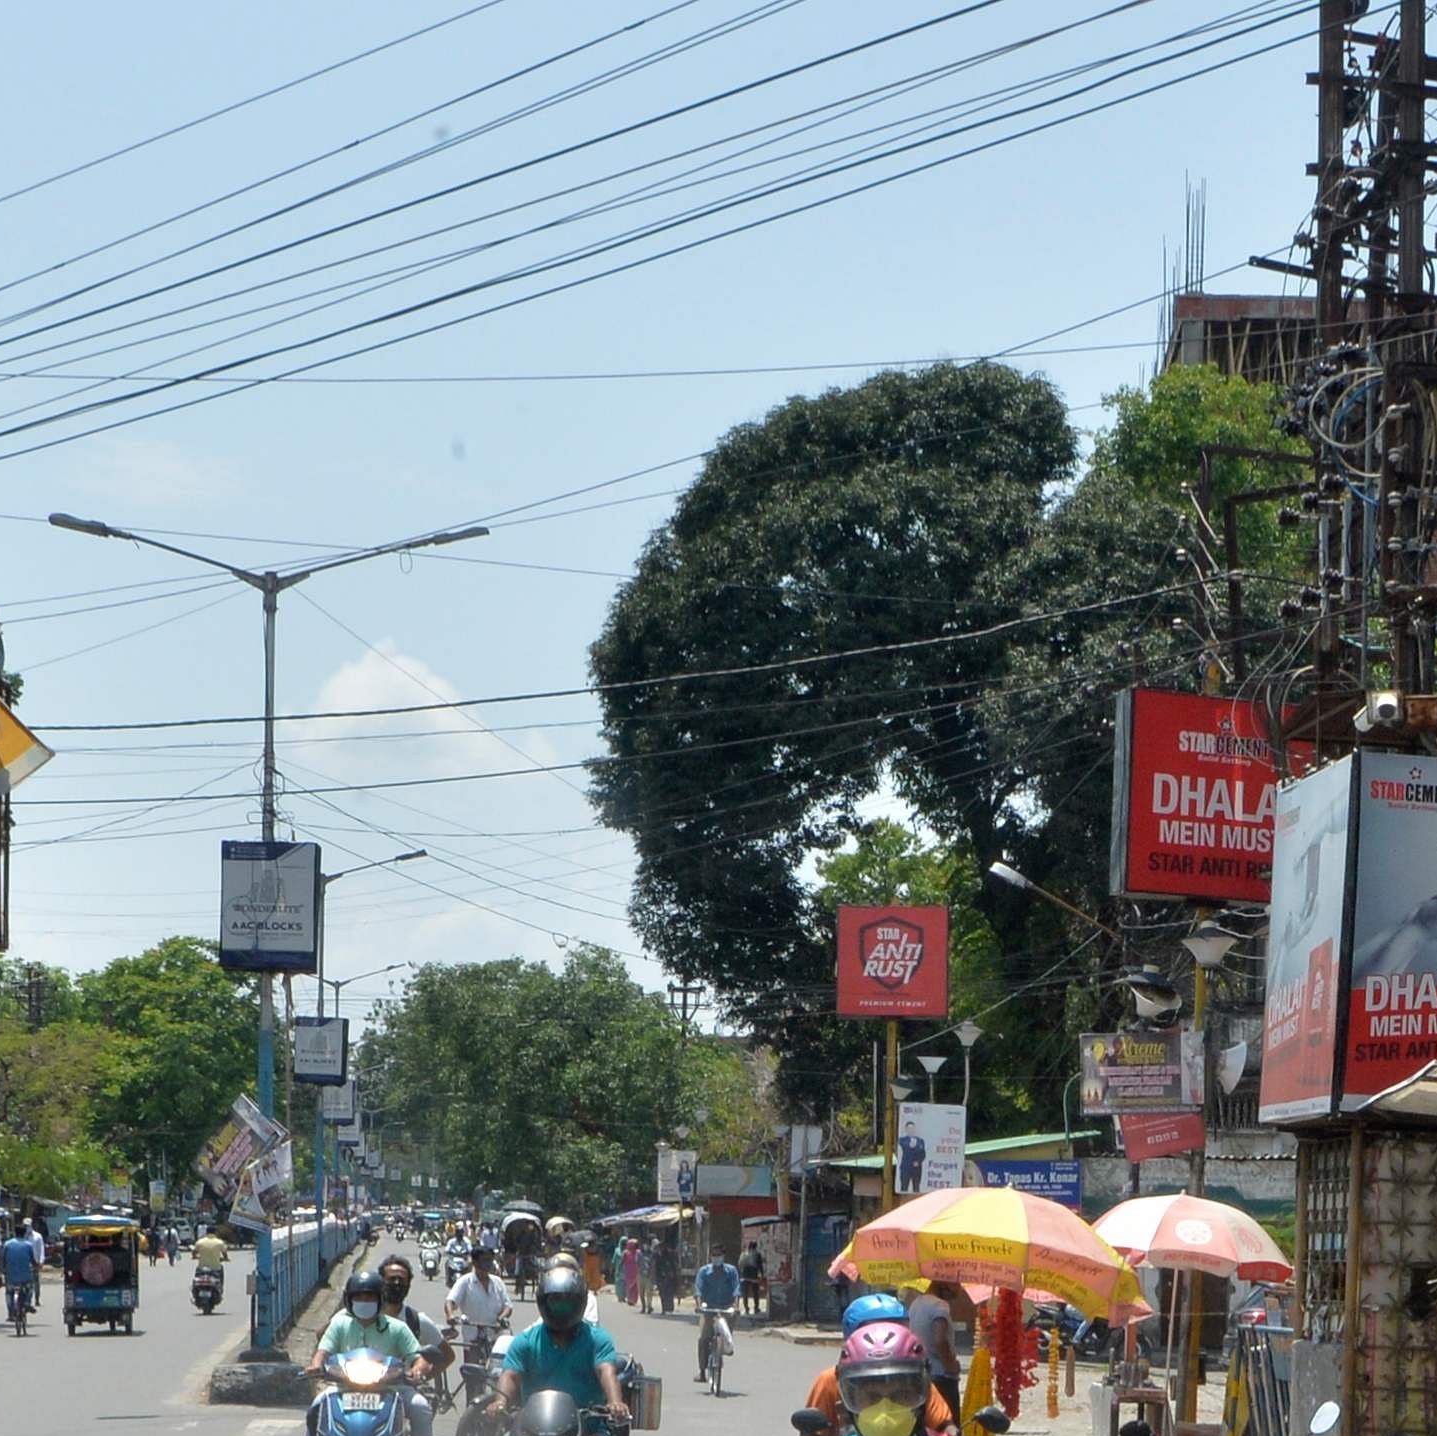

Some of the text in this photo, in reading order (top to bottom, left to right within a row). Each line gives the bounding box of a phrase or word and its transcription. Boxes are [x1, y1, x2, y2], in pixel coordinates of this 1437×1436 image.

[1152, 772, 1278, 824] DHALA
[1158, 818, 1276, 854] MEIN MUS
[1148, 851, 1195, 874] STAR
[1198, 856, 1241, 879] ANTI
[231, 920, 303, 931] AAC BLOCKS
[876, 928, 900, 940] STAR
[868, 933, 923, 960] ANTI
[863, 959, 918, 985] RUST
[1370, 1013, 1422, 1038] MEIN
[1354, 1042, 1400, 1062] STAR
[987, 1172, 1001, 1184] Dr.
[1034, 1172, 1047, 1184] Kr.
[1049, 1172, 1078, 1184] Konar
